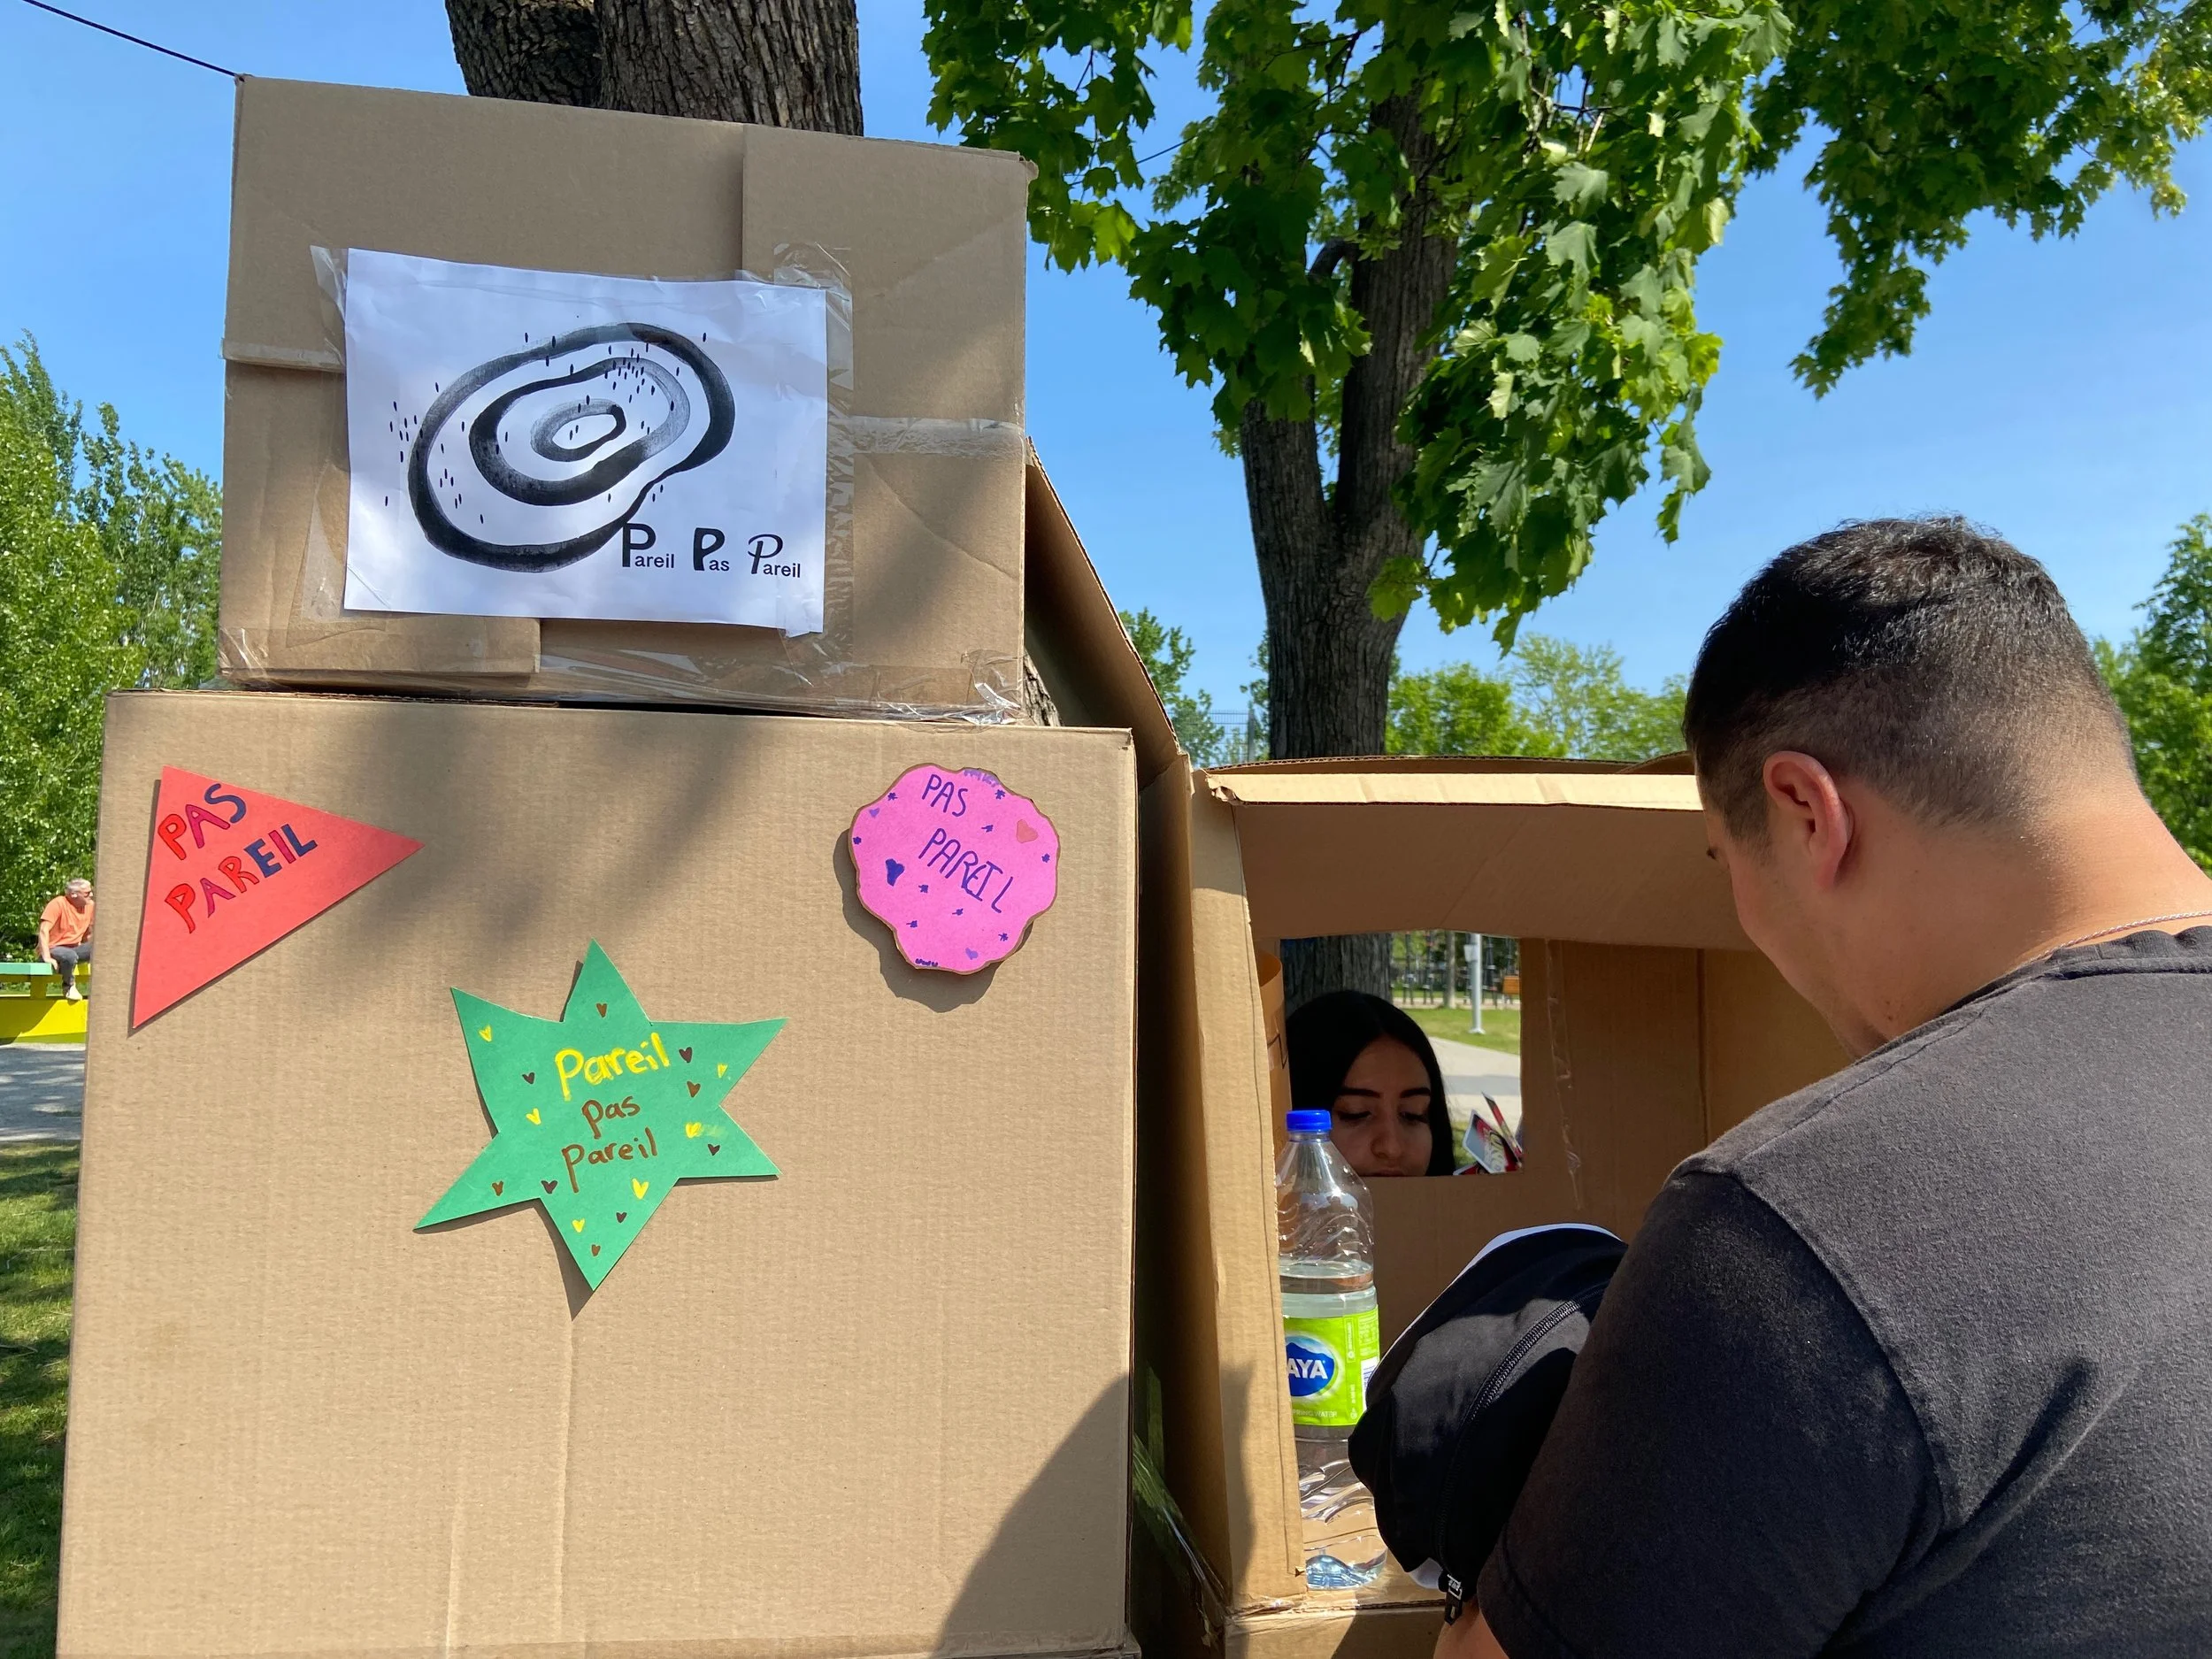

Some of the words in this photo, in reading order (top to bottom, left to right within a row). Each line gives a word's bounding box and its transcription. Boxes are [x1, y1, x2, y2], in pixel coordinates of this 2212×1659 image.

[622, 522, 675, 569] Pareil
[693, 527, 730, 572] Pas
[748, 534, 801, 579] Pareil
[157, 783, 247, 861] PAS
[922, 773, 968, 818] PAS
[165, 824, 318, 934] PAREIL
[918, 827, 1014, 914] PAREIL
[1286, 1357, 1328, 1379] AYA
